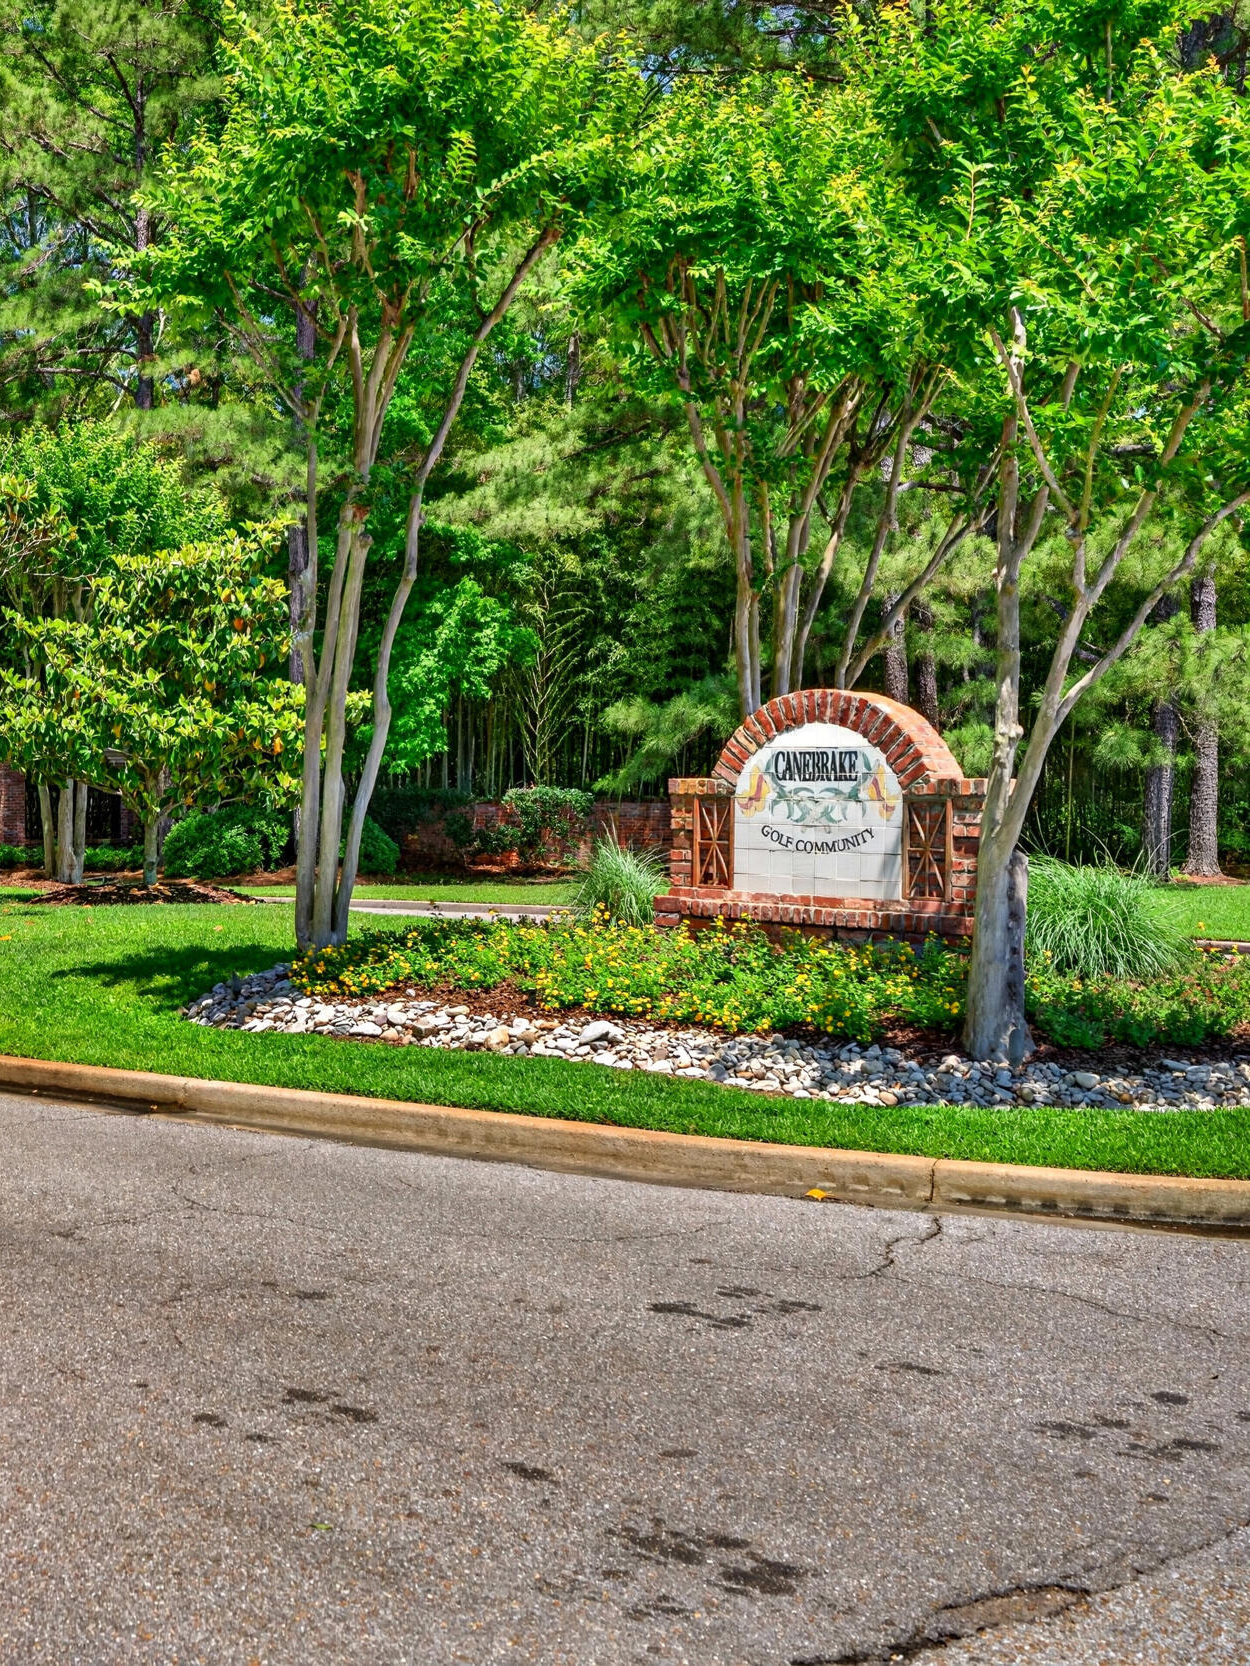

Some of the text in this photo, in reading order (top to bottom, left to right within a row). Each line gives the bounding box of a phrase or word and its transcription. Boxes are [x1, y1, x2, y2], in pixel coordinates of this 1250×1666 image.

[775, 751, 858, 781] CANEBRAKE
[761, 824, 874, 854] GOLF COMMUNITY
